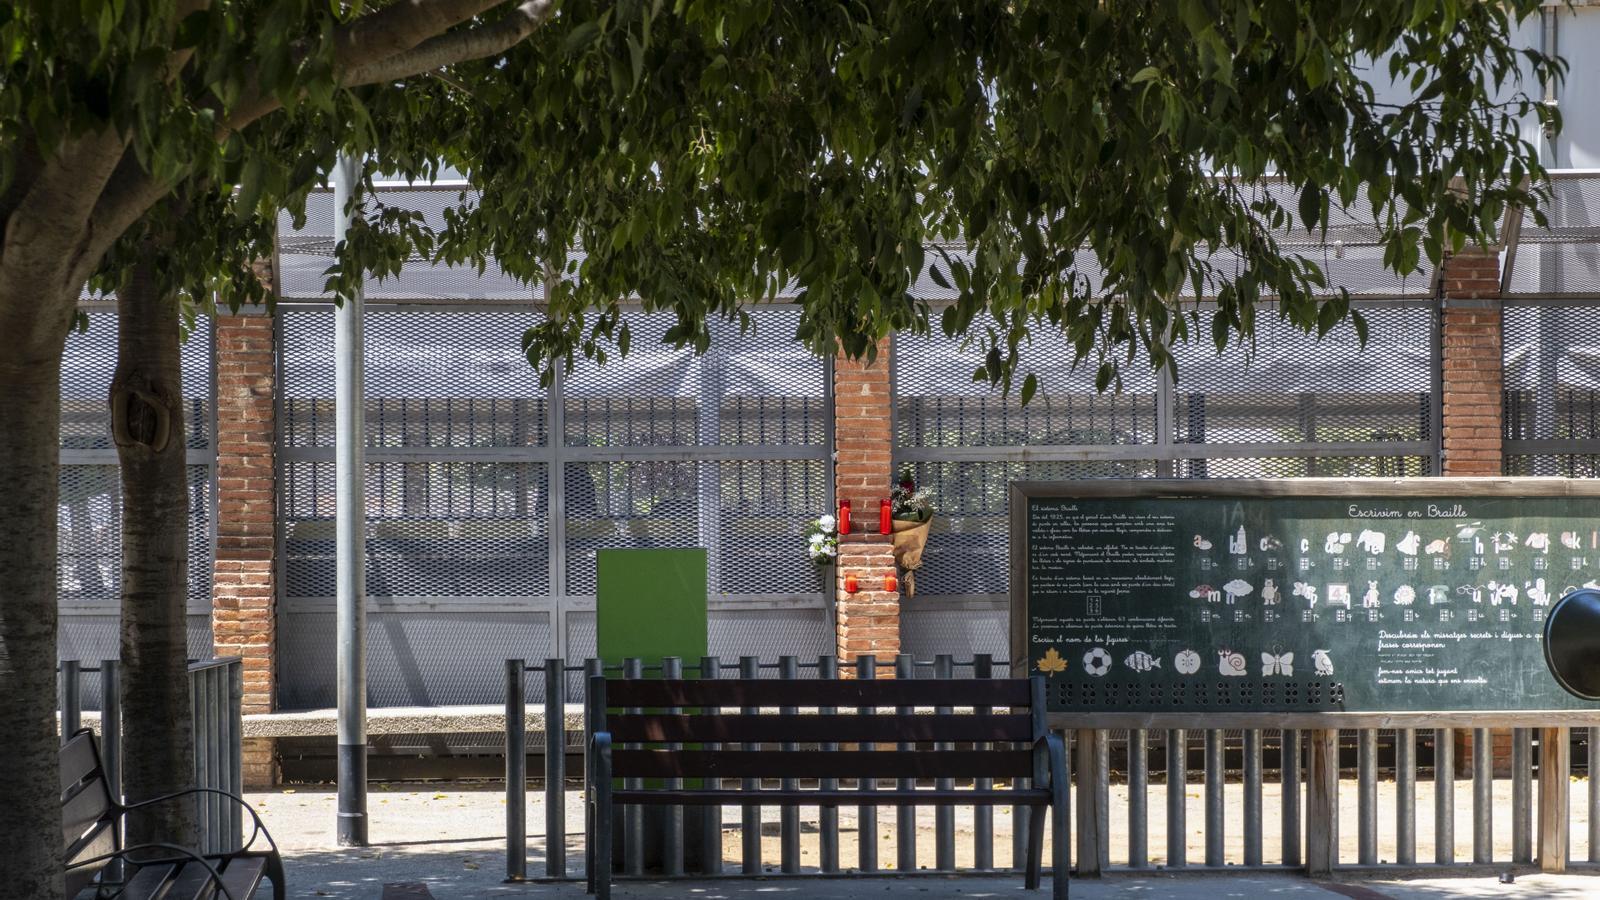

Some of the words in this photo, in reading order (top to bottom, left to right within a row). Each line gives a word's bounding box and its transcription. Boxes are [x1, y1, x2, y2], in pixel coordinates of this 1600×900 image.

[1060, 504, 1079, 512] Braille
[1348, 504, 1402, 518] Escrivim
[1407, 510, 1422, 518] en
[1427, 504, 1468, 518] Braille
[1193, 534, 1202, 547] a
[1229, 535, 1238, 554] b
[1259, 538, 1268, 551] c
[1475, 536, 1484, 554] h
[1572, 531, 1581, 549] k
[1207, 590, 1221, 603] m
[1226, 592, 1235, 605] n
[1310, 593, 1318, 609] p
[1343, 592, 1351, 610] q
[1472, 590, 1482, 603] u
[1031, 634, 1055, 643] Escriu
[1056, 634, 1064, 643] el
[1083, 634, 1093, 643] de
[1093, 634, 1105, 643] les
[1104, 634, 1129, 646] figures
[1420, 630, 1431, 639] els
[1433, 630, 1467, 642] missatges
[1470, 630, 1494, 639] secrets
[1377, 640, 1400, 652] frases
[1436, 667, 1459, 677] jugant
[1404, 676, 1413, 684] la
[1413, 676, 1437, 684] natura
[1437, 678, 1449, 686] que
